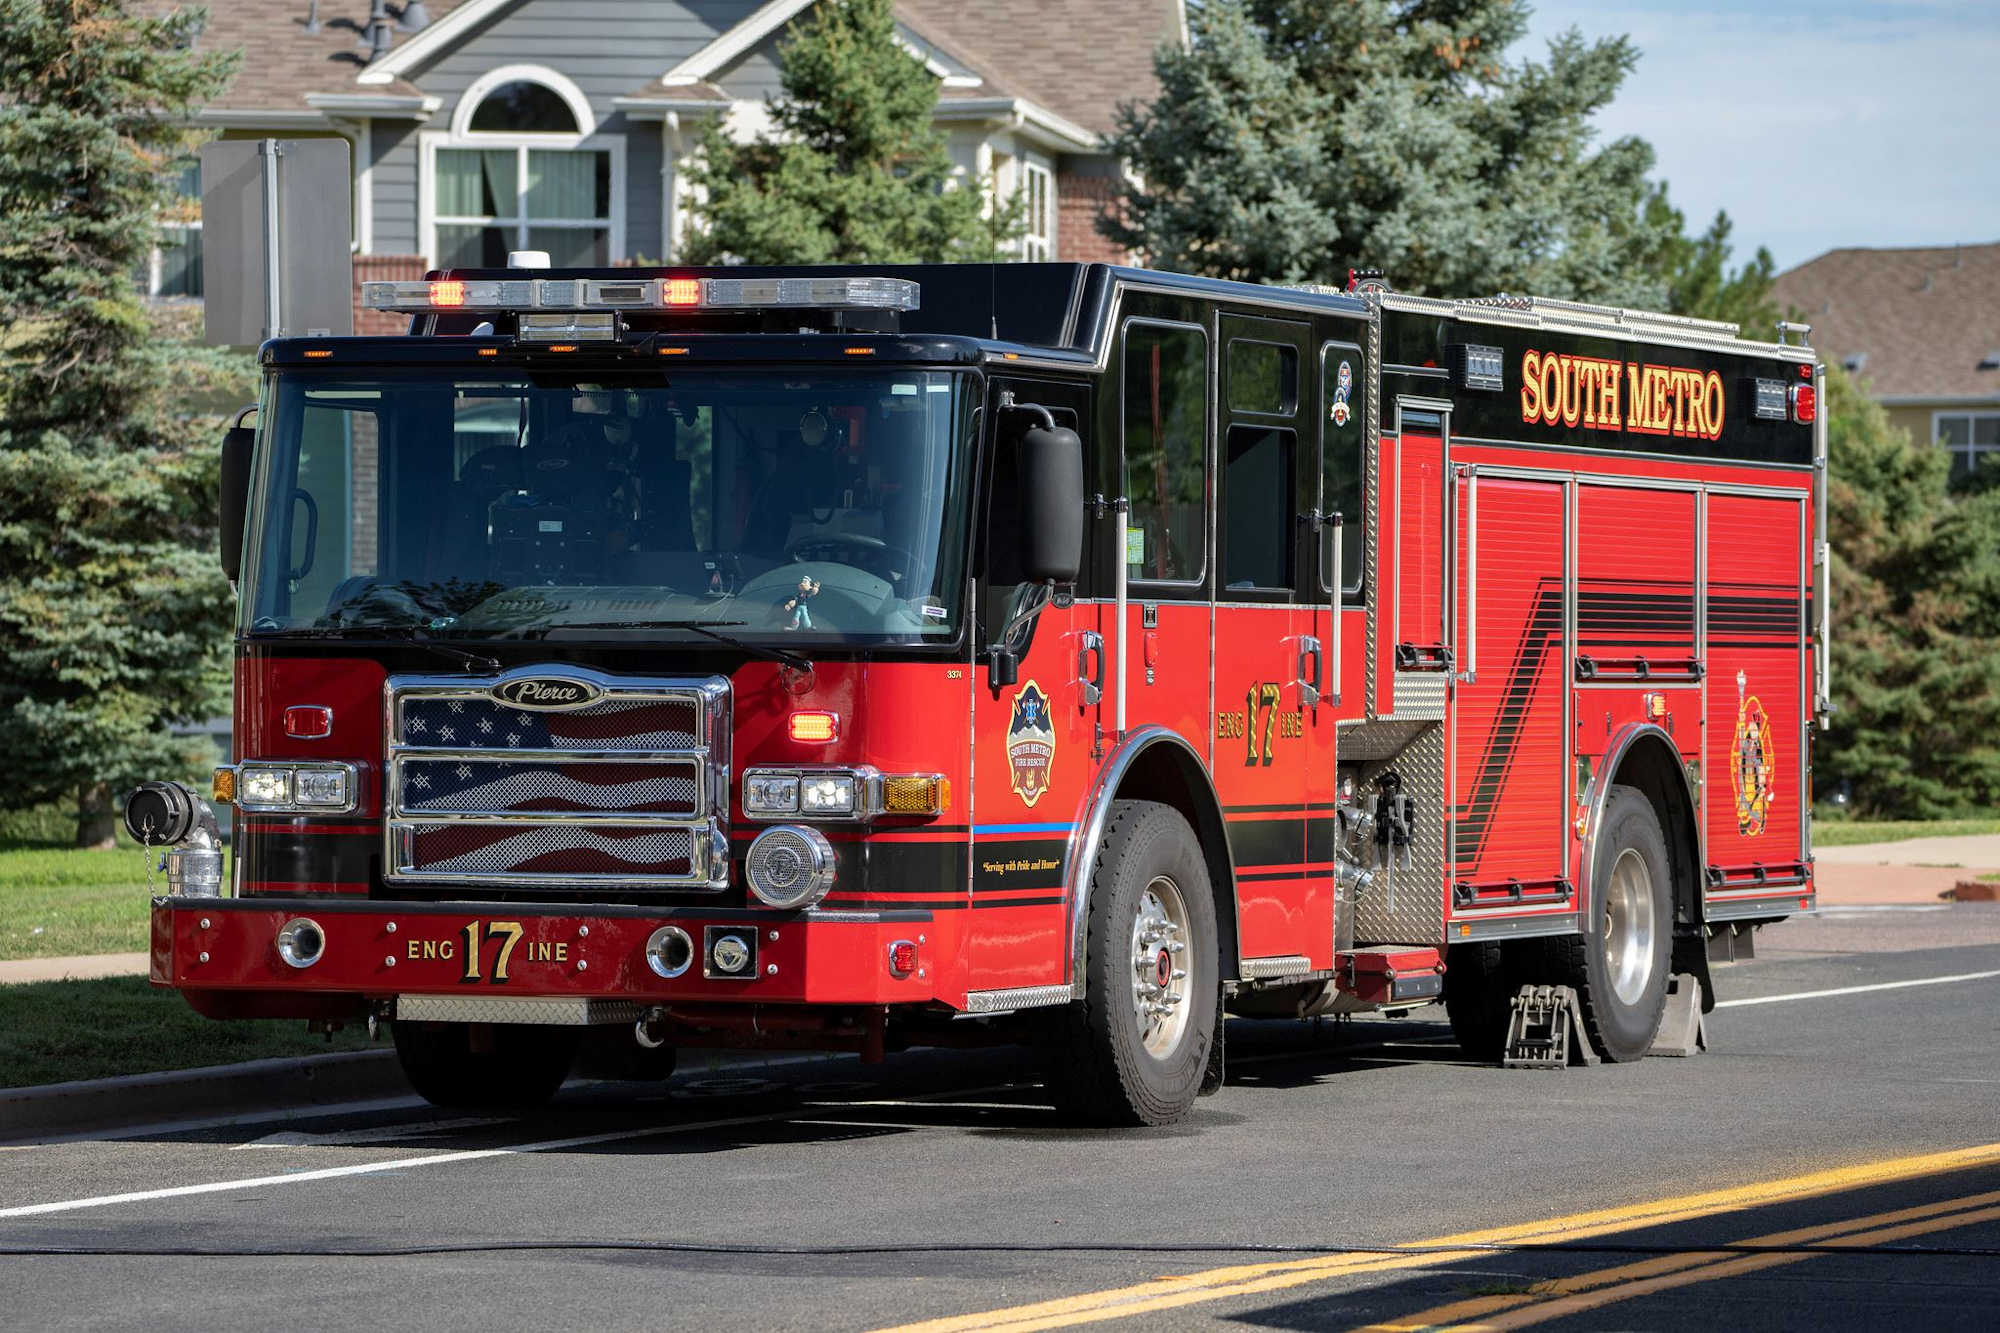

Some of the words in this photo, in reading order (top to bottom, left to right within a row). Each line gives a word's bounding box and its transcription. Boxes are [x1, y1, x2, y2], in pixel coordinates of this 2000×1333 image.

[1521, 349, 1622, 431] SOUTH
[1627, 362, 1725, 441] METRO
[515, 681, 578, 702] Pierce
[1217, 712, 1243, 739] ENG
[1246, 681, 1281, 766] 17
[1281, 712, 1303, 739] INE
[1010, 744, 1030, 759] SOUTH
[1030, 744, 1051, 758] METRO
[1015, 758, 1026, 767] FIRE
[1027, 758, 1046, 767] RESCUE
[1005, 860, 1016, 871] with
[1017, 859, 1031, 871] Pride
[1031, 859, 1041, 870] and
[407, 940, 454, 960] ENG
[461, 920, 524, 983] 17
[528, 942, 568, 961] INE
